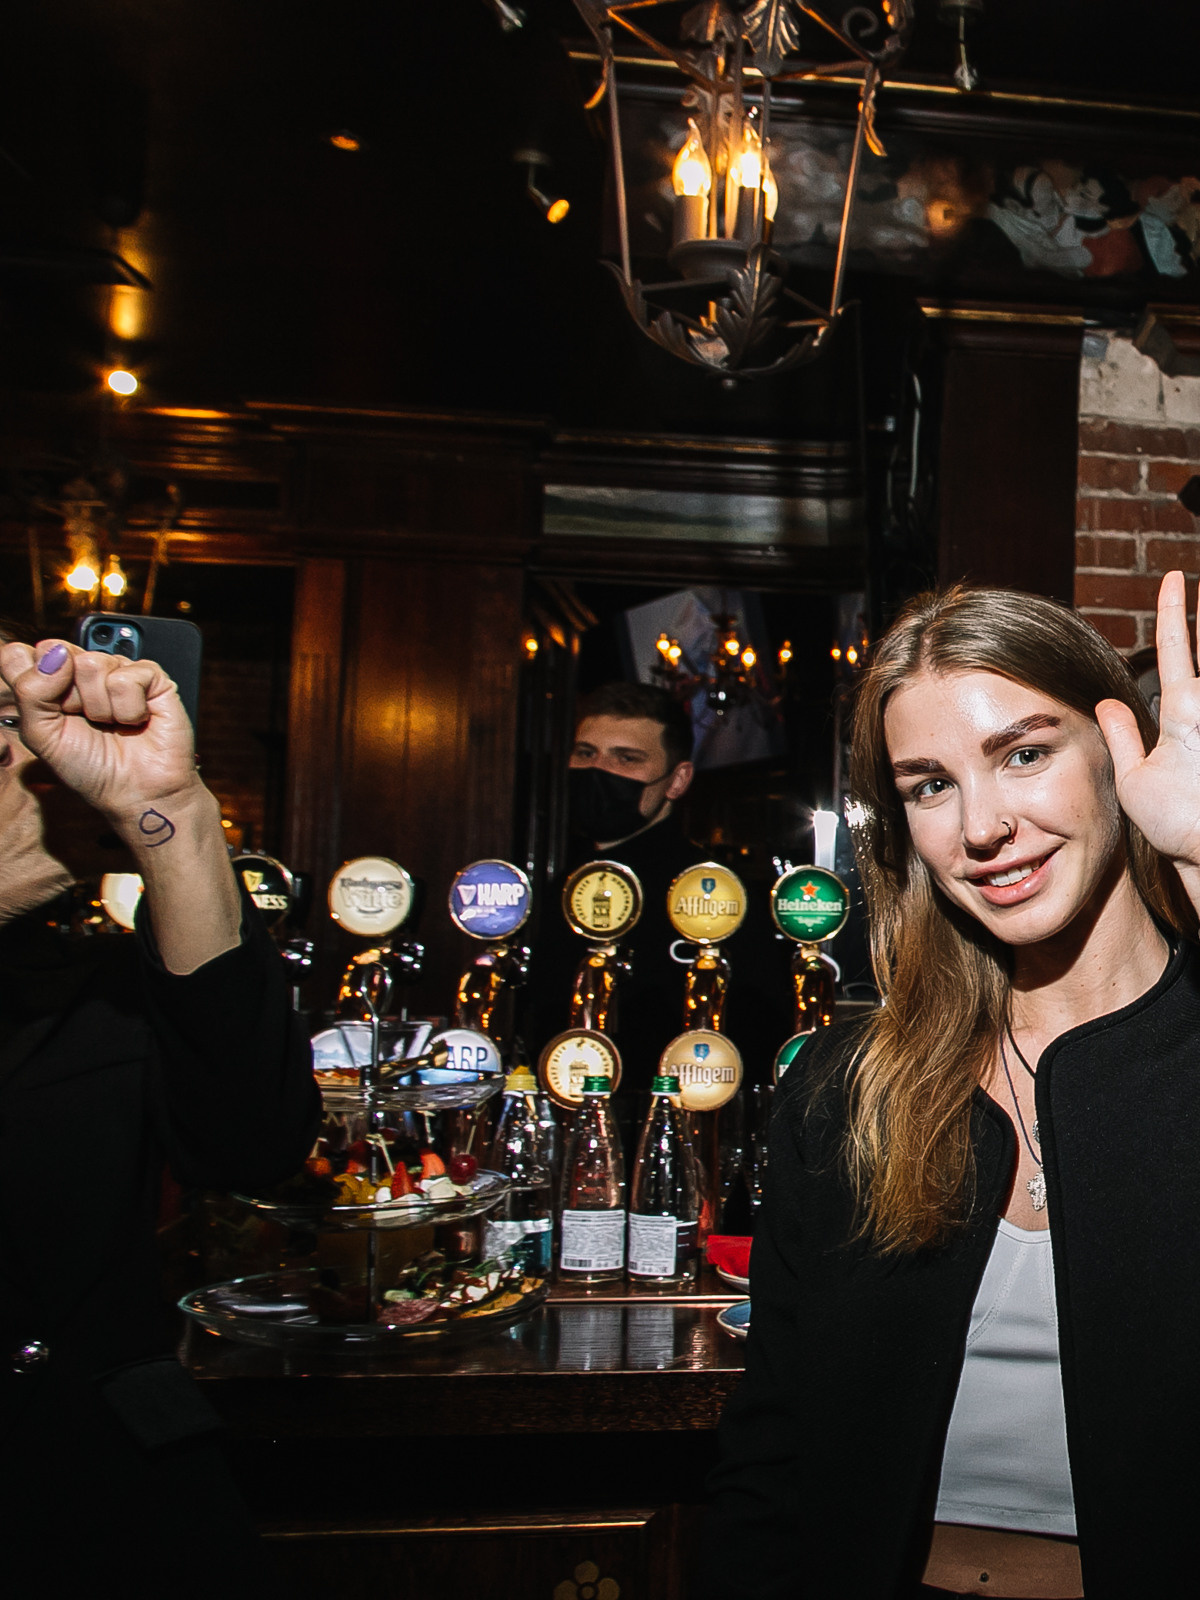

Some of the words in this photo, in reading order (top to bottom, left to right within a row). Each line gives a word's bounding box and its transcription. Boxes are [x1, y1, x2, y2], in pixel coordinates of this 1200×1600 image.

[477, 883, 525, 906] HARP
[777, 898, 843, 912] Heineken
[674, 895, 740, 918] Affligem
[446, 1046, 489, 1071] ARP
